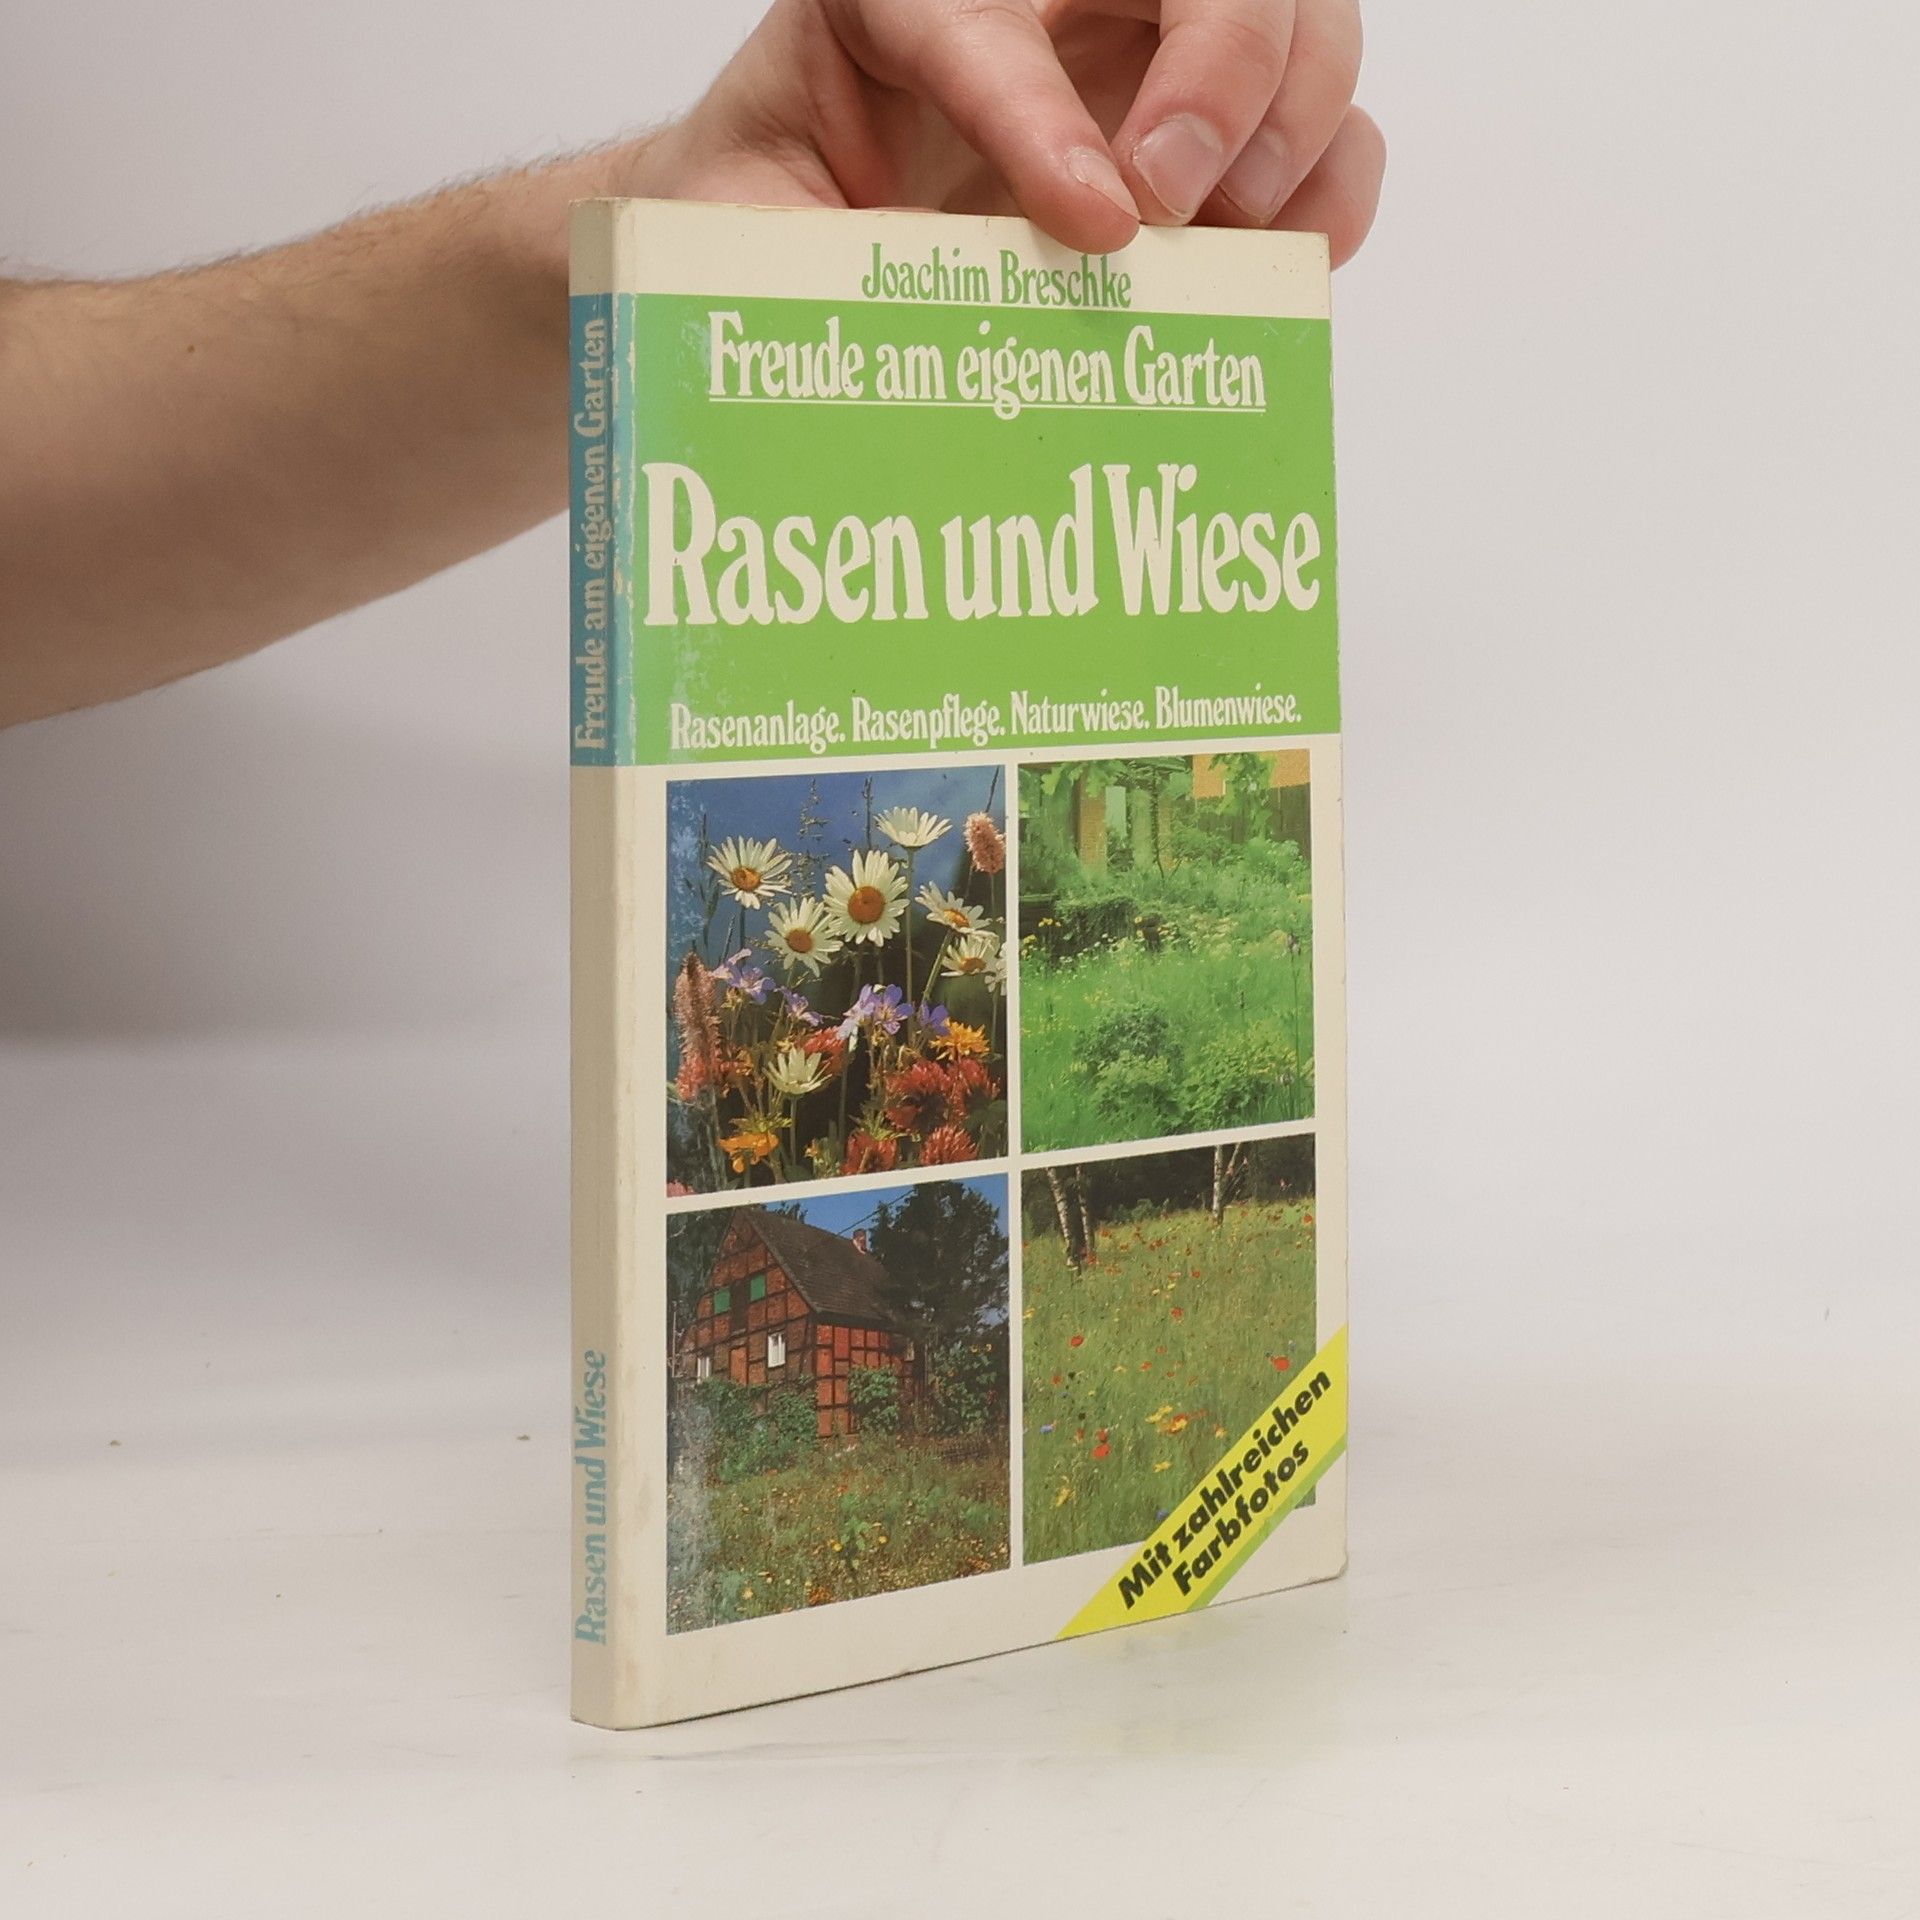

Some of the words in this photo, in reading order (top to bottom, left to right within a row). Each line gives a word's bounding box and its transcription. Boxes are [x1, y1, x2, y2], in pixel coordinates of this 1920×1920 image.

[862, 242, 992, 303] Joachim
[999, 249, 1132, 308] Breschke
[573, 318, 609, 438] Garten
[708, 311, 864, 399] Freude
[876, 340, 946, 400] am
[957, 320, 1117, 420] eigenen
[1124, 325, 1266, 407] Garten
[575, 445, 612, 569] eigenen
[643, 462, 929, 626] Rasen
[941, 464, 1100, 621] und
[1102, 463, 1321, 616] Wiese
[584, 577, 607, 631] am
[573, 637, 609, 751] Freude
[670, 702, 846, 754] Rasenanlage.
[852, 693, 1006, 743] Rasenpflege.
[1010, 690, 1150, 735] Naturwiese.
[1155, 684, 1302, 729] Blumenwiese.
[575, 1349, 607, 1449] Wiese
[575, 1456, 607, 1526] und
[1117, 1541, 1174, 1610] Mit
[1172, 1371, 1332, 1553] zahlreichen
[1172, 1440, 1310, 1596] Farbfotos
[575, 1533, 607, 1646] Rasen
